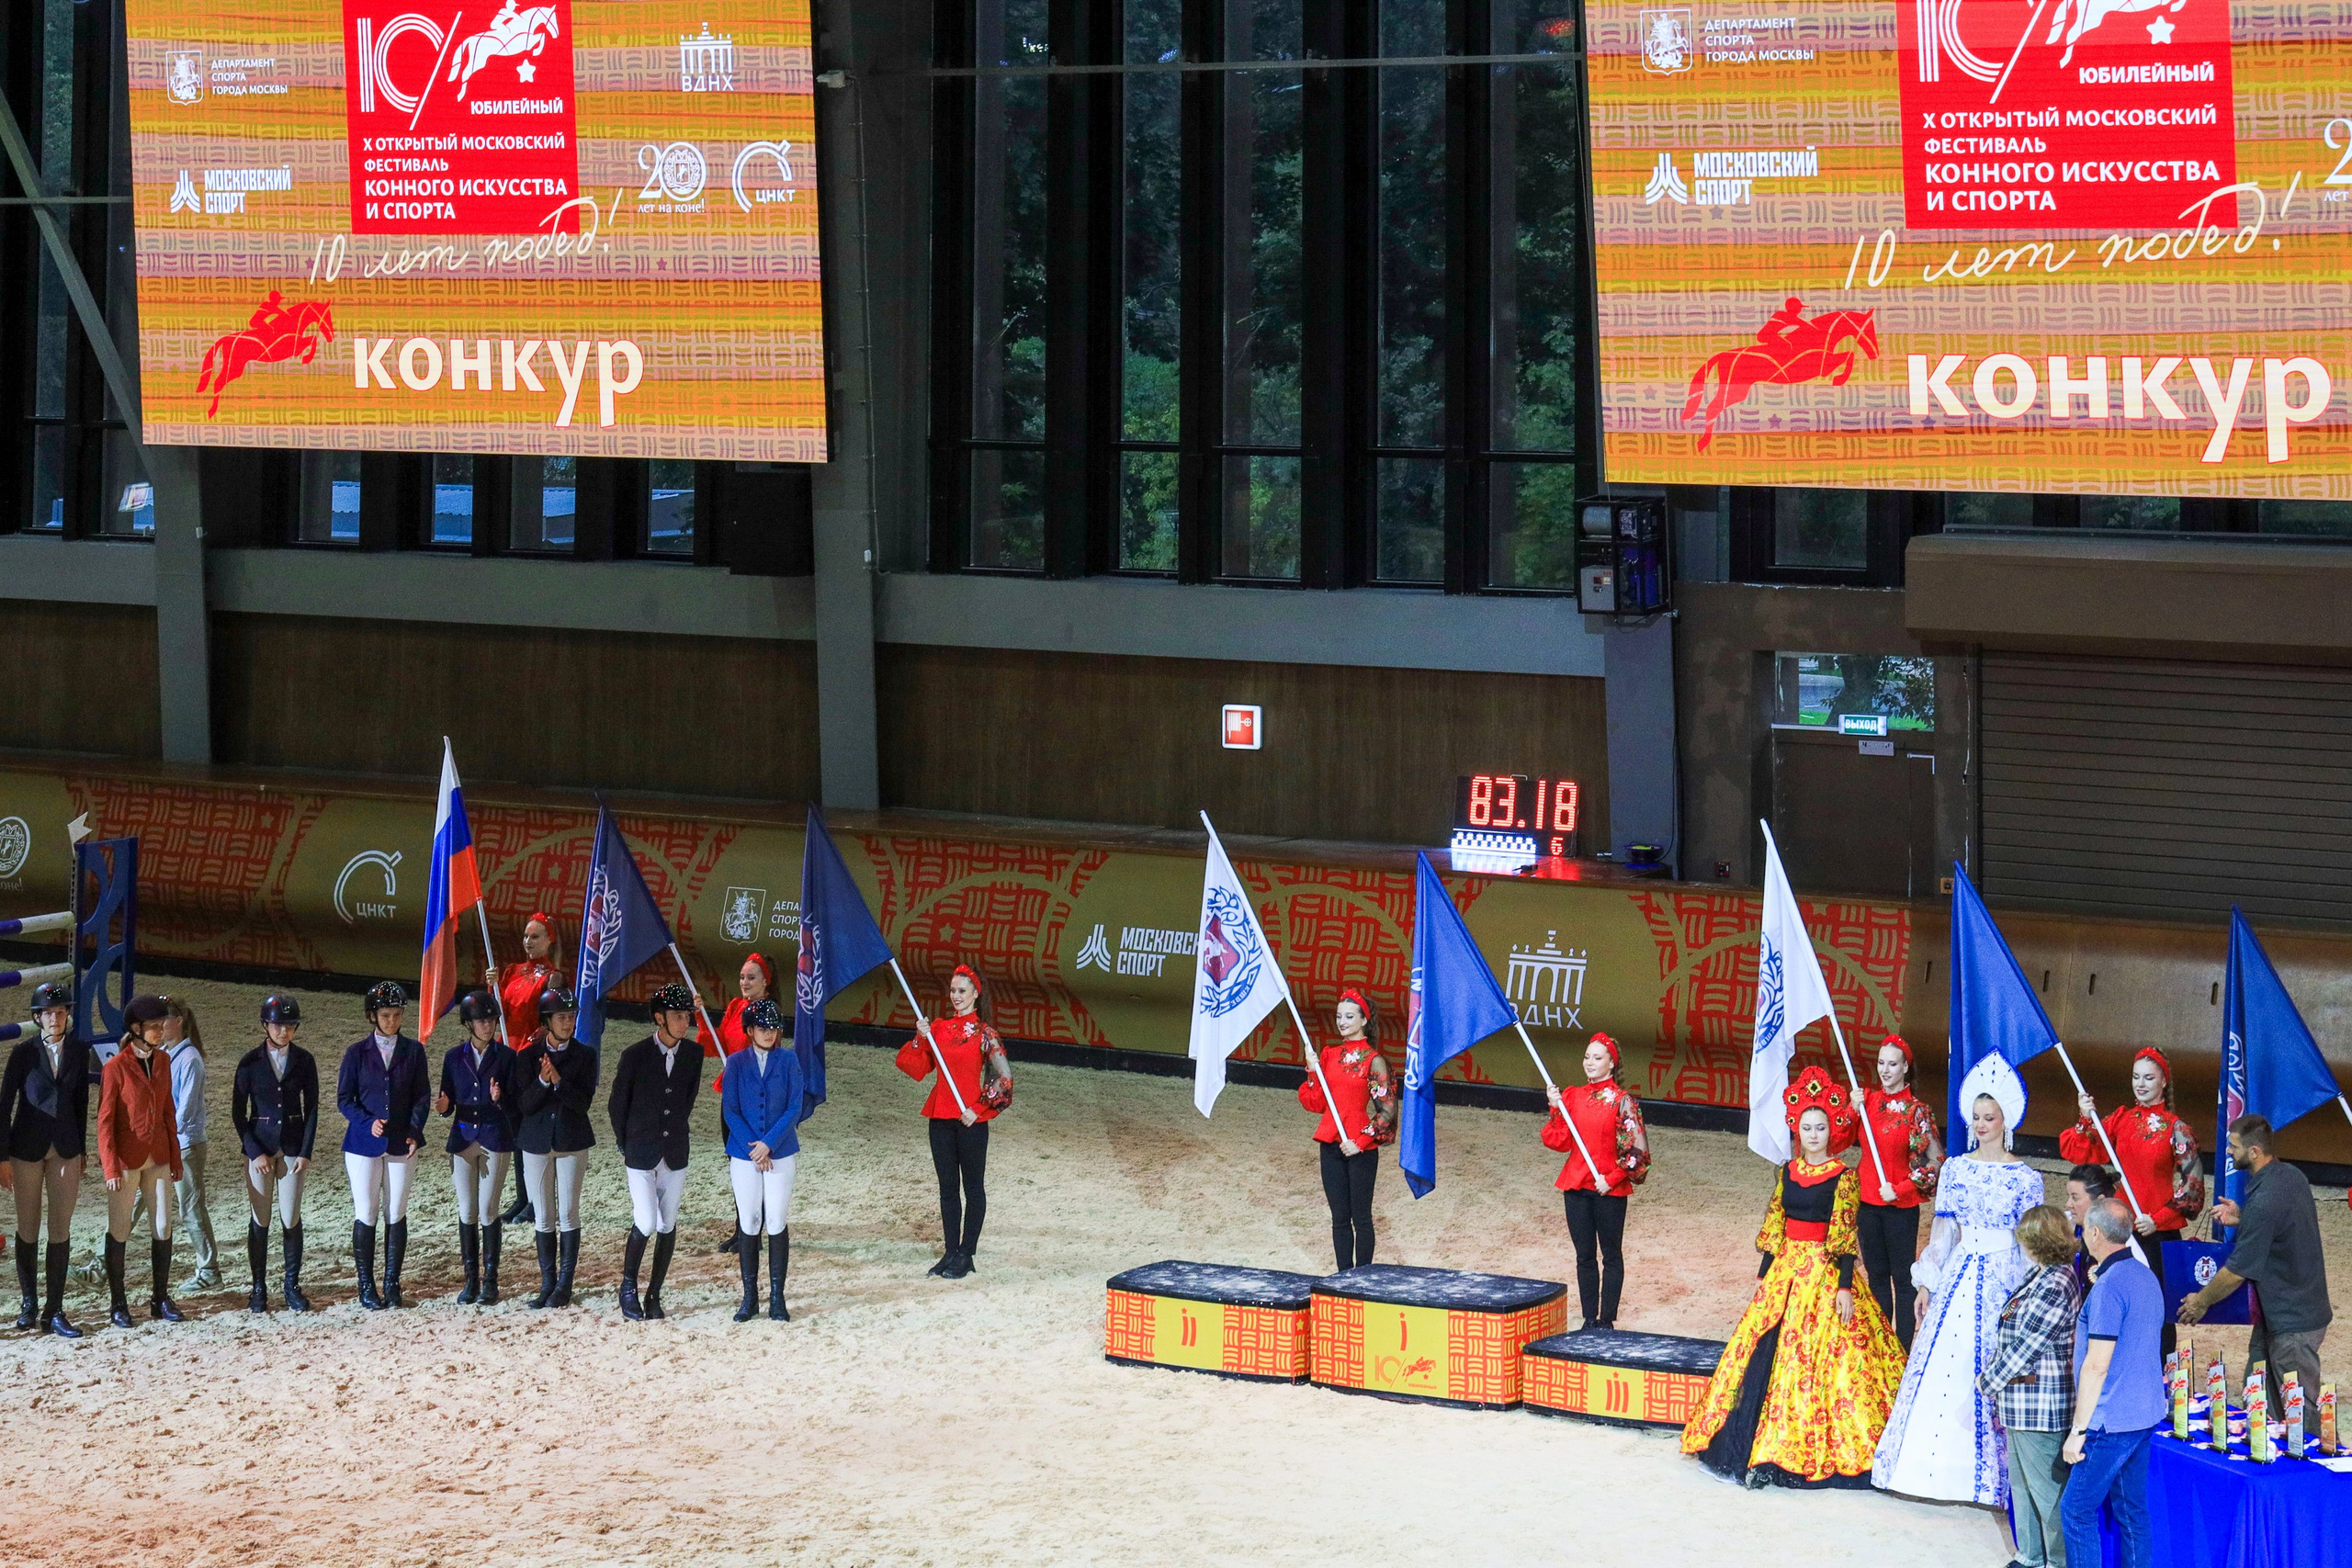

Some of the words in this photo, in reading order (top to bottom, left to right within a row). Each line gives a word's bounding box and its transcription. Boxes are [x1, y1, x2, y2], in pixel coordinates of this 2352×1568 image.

[1704, 17, 1796, 32] ДЕПАРТАМЕНТ
[1705, 35, 1755, 46] СПОРТА
[211, 59, 276, 70] ДЕПАРТАМЕНТ
[1706, 50, 1756, 62] ГОРОДА
[1758, 49, 1814, 61] МОСКВЫ
[211, 73, 246, 82] СПОРТА
[2078, 62, 2215, 85] ЮБИЛЕЙНЫЙ
[212, 85, 247, 96] ГОРОДА
[249, 84, 288, 95] МОСКВЫ
[682, 75, 735, 92] ВДНХ
[470, 97, 563, 115] ЮБИЛЕЙНЫЙ
[1940, 106, 2060, 129] ОТКРЫТЫЙ
[2066, 103, 2217, 128] МОСКОВСКИЙ
[375, 133, 458, 152] ОТКРЫТЫЙ
[461, 132, 565, 151] МОСКОВСКИЙ
[1924, 136, 2047, 154] ФЕСТИВАЛЬ
[2324, 118, 2352, 184] 2
[364, 158, 449, 173] ФЕСТИВАЛЬ
[1693, 145, 1818, 178] МОСКОВСКИЙ
[204, 164, 292, 191] МОСКОВСКИЙ
[1926, 162, 2055, 184] КОННОГО
[2063, 160, 2221, 183] ИСКУССТВА
[365, 179, 455, 197] КОННОГО
[459, 177, 568, 197] ИСКУССТВА
[1695, 179, 1753, 205] СПОРТ
[2324, 189, 2349, 202] лет
[205, 192, 245, 214] СПОРТ
[755, 188, 796, 205] ЦНКТ
[1927, 191, 1944, 210] И
[1951, 189, 2057, 211] СПОРТА
[367, 203, 379, 220] И
[382, 202, 456, 220] СПОРТА
[638, 202, 657, 213] лет
[659, 203, 672, 213] на
[674, 200, 705, 213] коне!
[309, 233, 346, 286] 10
[364, 239, 469, 277] лет
[483, 187, 623, 267] побед!
[1843, 229, 1896, 290] 10
[1924, 236, 2076, 282] лет
[2098, 170, 2301, 268] побед!
[353, 336, 644, 428] конкур
[1906, 352, 2333, 465] конкур
[1845, 719, 1877, 732] ВЫХОД
[1469, 775, 1577, 831] 83.18
[0, 877, 24, 892] оне!
[356, 902, 397, 919] ЦНКТ
[773, 901, 802, 912] ДЕПА
[772, 914, 801, 926] СПОРТ
[769, 928, 800, 942] ГОРОД
[1120, 927, 1199, 955] МОСКОВСК
[1116, 951, 1166, 977] СПОРТ
